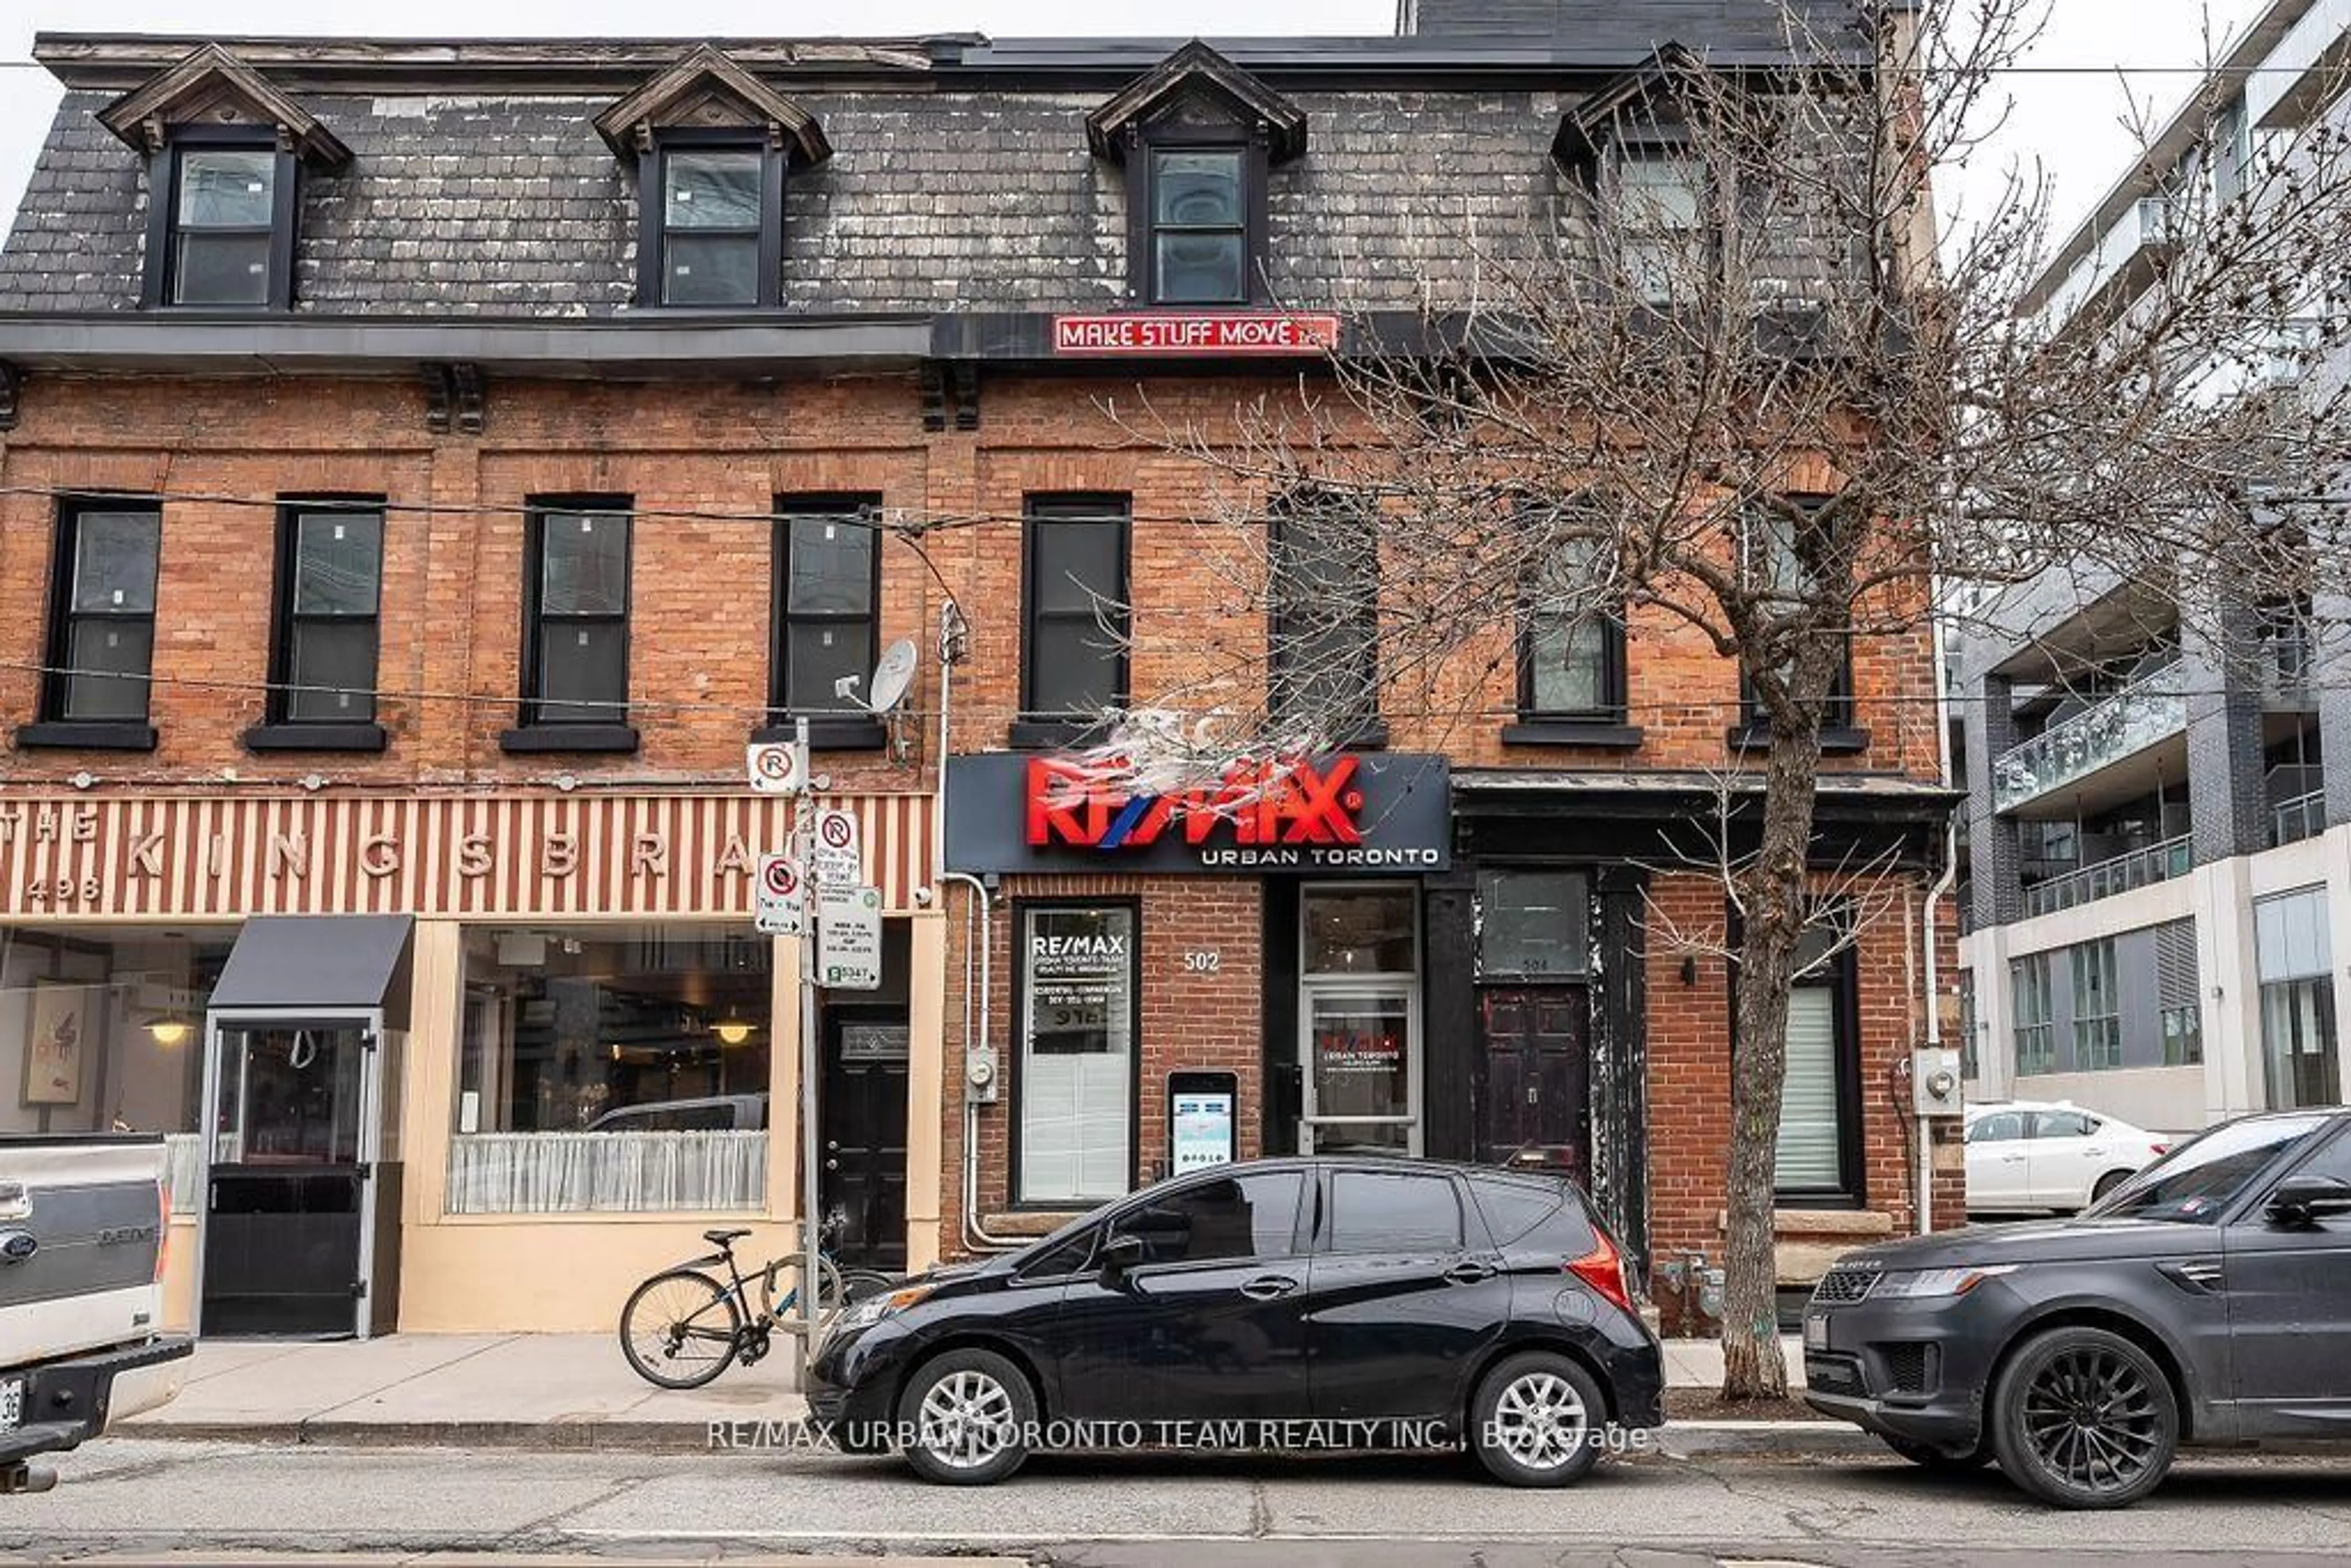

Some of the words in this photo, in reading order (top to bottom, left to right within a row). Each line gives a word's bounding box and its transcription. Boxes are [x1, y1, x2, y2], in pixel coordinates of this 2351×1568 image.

[1062, 323, 1133, 345] MAKE
[1142, 322, 1213, 345] STUFF
[1221, 321, 1291, 344] MOVE
[0, 812, 97, 842] THE
[1202, 850, 1299, 865] URBAN
[1311, 849, 1438, 865] TORONTO
[28, 876, 99, 901] 498
[1032, 935, 1124, 956] RE/MAX
[1184, 952, 1219, 971] 502
